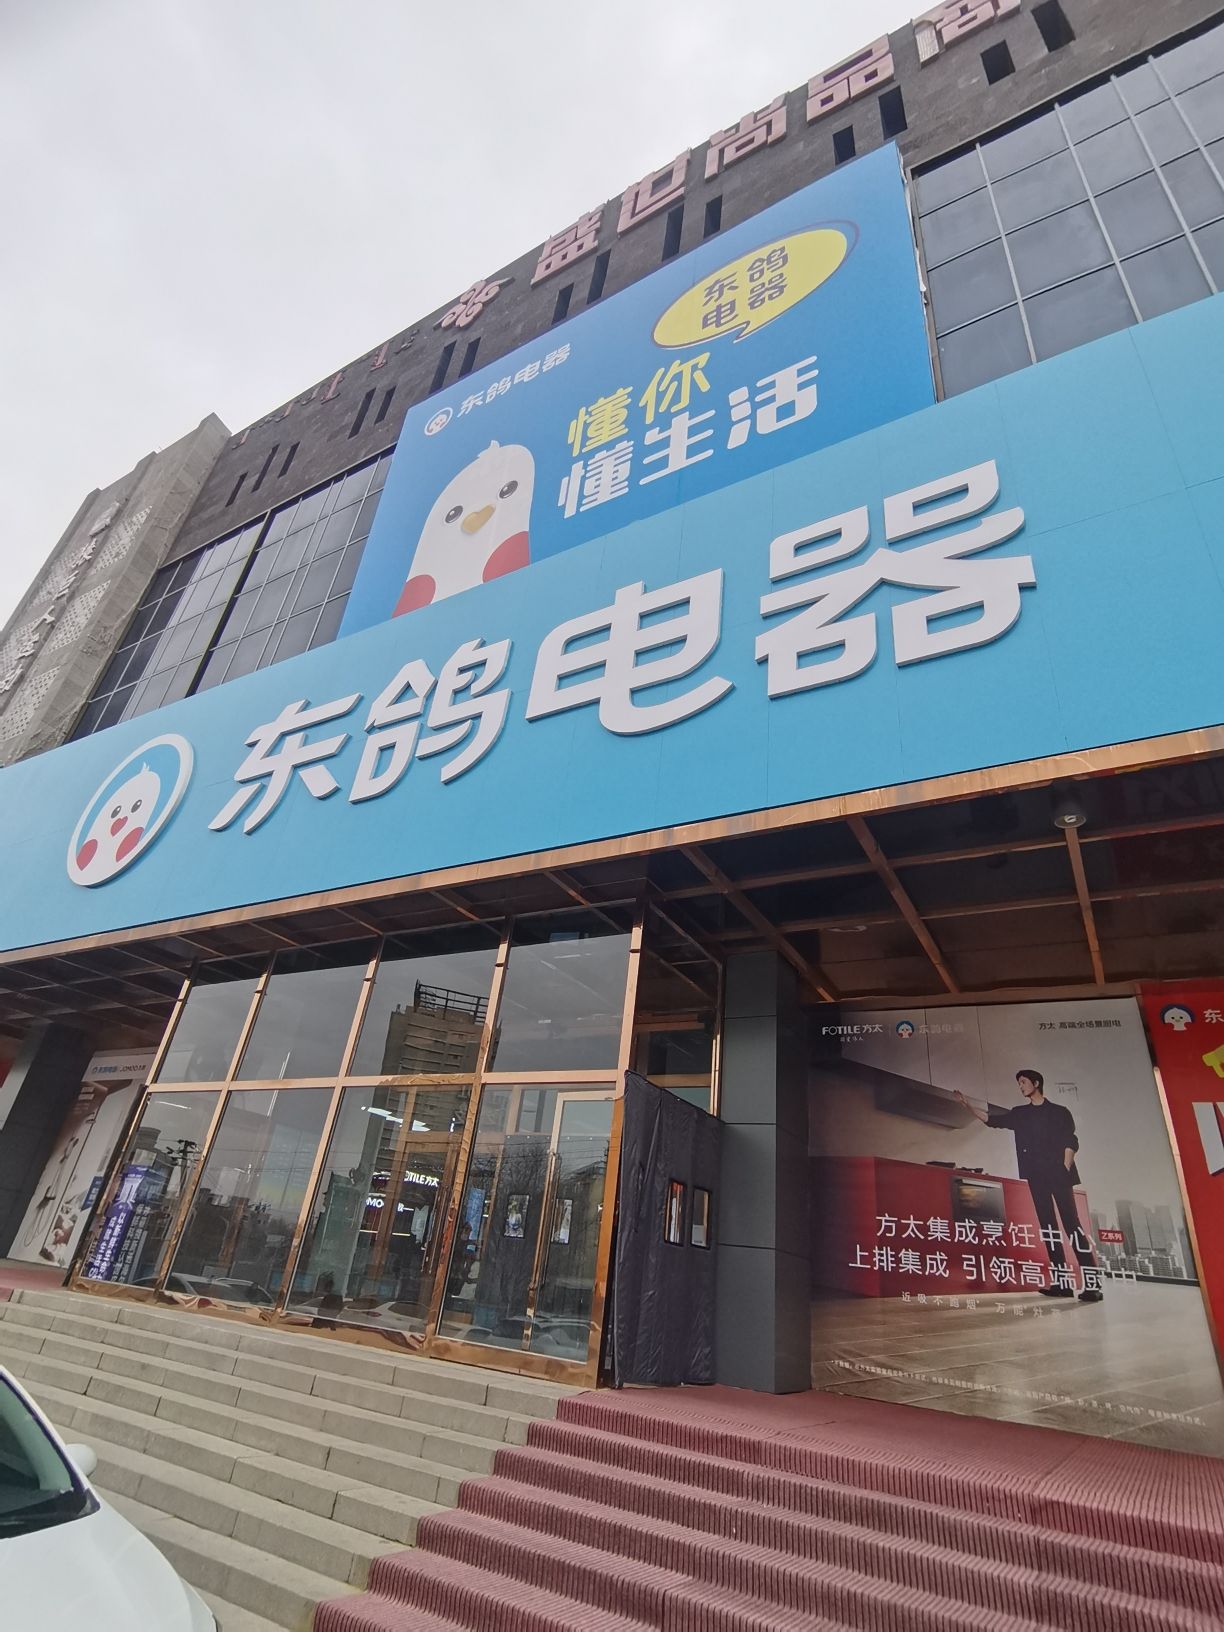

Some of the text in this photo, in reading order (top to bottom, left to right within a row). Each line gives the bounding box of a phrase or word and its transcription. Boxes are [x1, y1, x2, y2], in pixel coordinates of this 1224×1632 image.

[702, 277, 787, 330] 电器
[703, 246, 788, 307] 东鸽
[457, 343, 571, 418] 东鸽电器
[567, 352, 711, 457] 懂你
[558, 355, 819, 518] 懂生活
[208, 460, 1037, 835] 东鸽电器
[849, 1244, 950, 1278] 上排集成
[876, 1213, 1097, 1254] 方太集成烹饪中心
